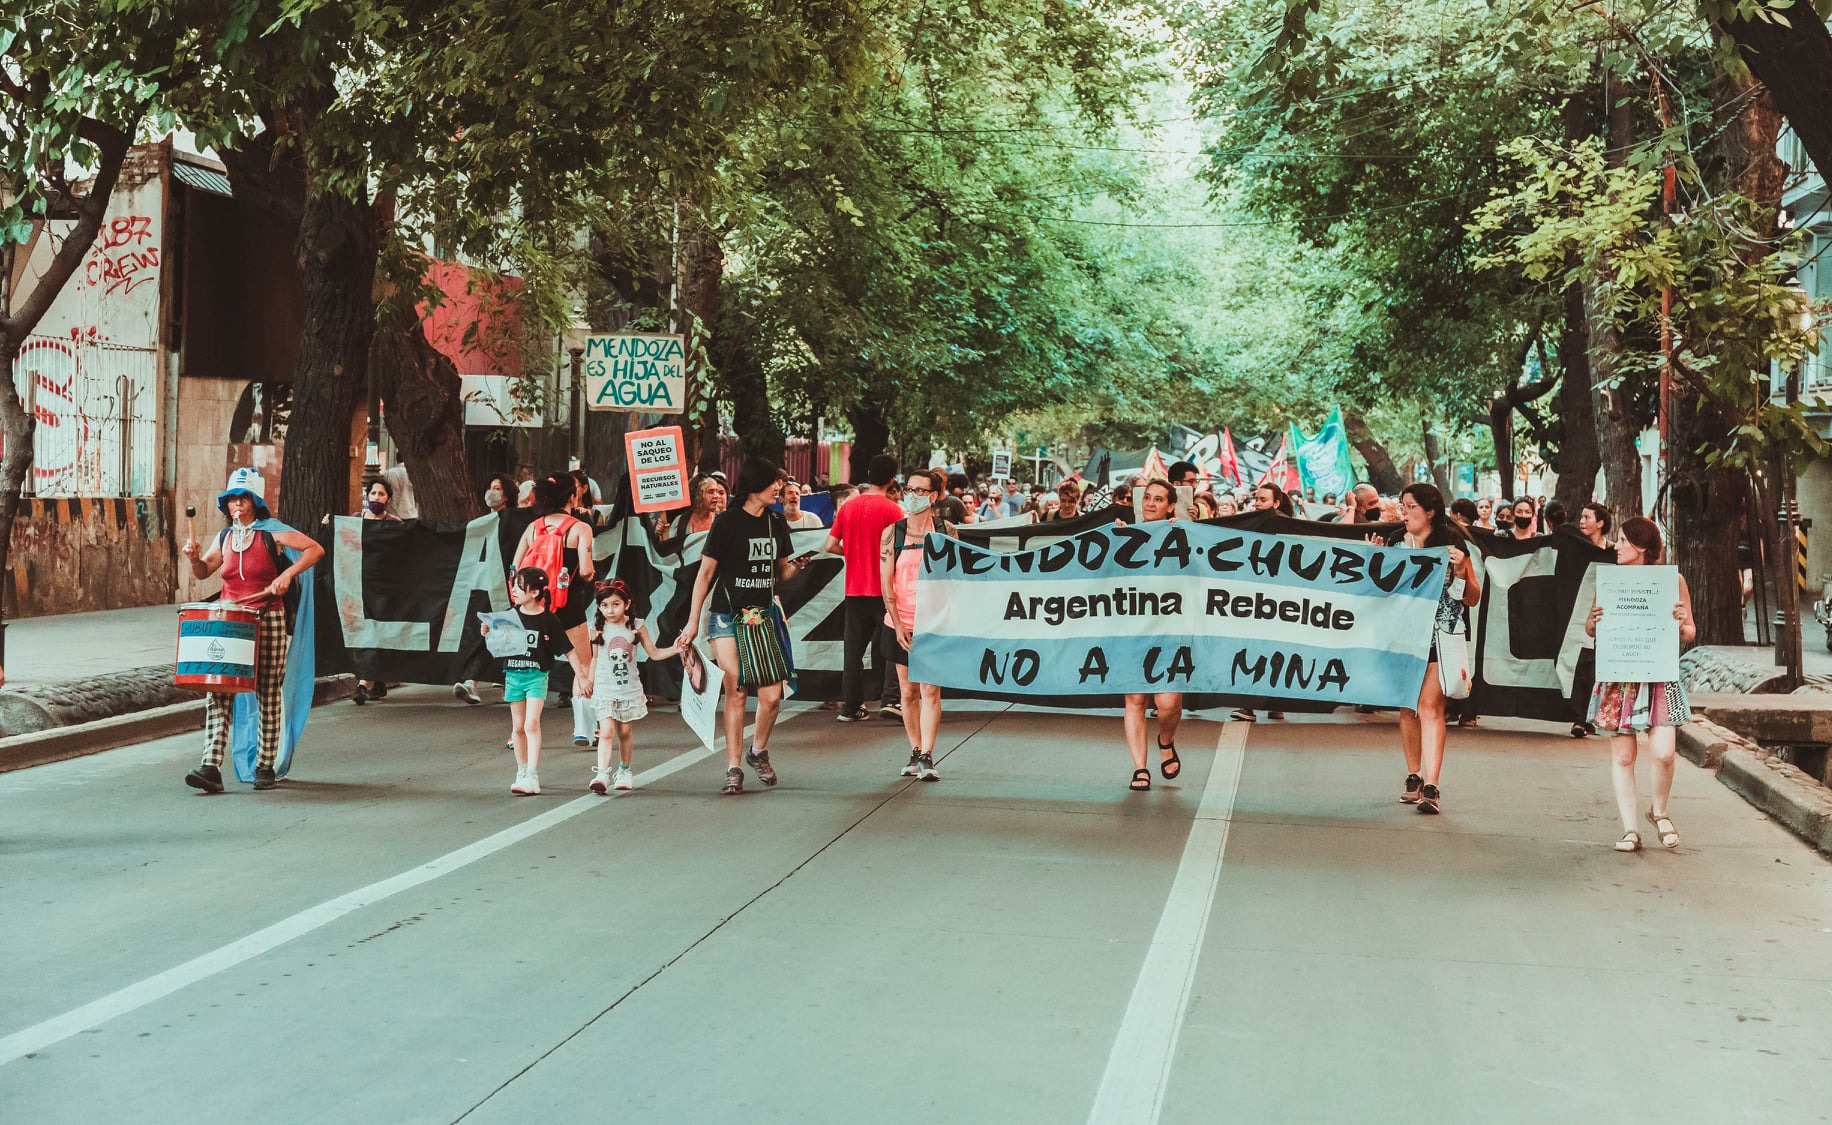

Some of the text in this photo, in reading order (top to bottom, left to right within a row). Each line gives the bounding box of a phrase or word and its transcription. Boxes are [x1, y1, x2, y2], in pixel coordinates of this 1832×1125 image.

[87, 247, 159, 287] CREW
[586, 338, 684, 361] MENDOZA
[587, 357, 684, 381] ES HIJA DEL
[596, 379, 673, 406] AGUA
[637, 447, 672, 457] SAQUEO
[654, 455, 671, 463] LOS
[640, 481, 679, 490] NATURALES
[641, 475, 676, 483] RECURSOS
[752, 543, 773, 556] NO
[761, 564, 771, 572] la
[1003, 587, 1355, 630] Argentina Rebelde
[527, 633, 536, 645] O
[979, 646, 1350, 692] NO A LA MINA
